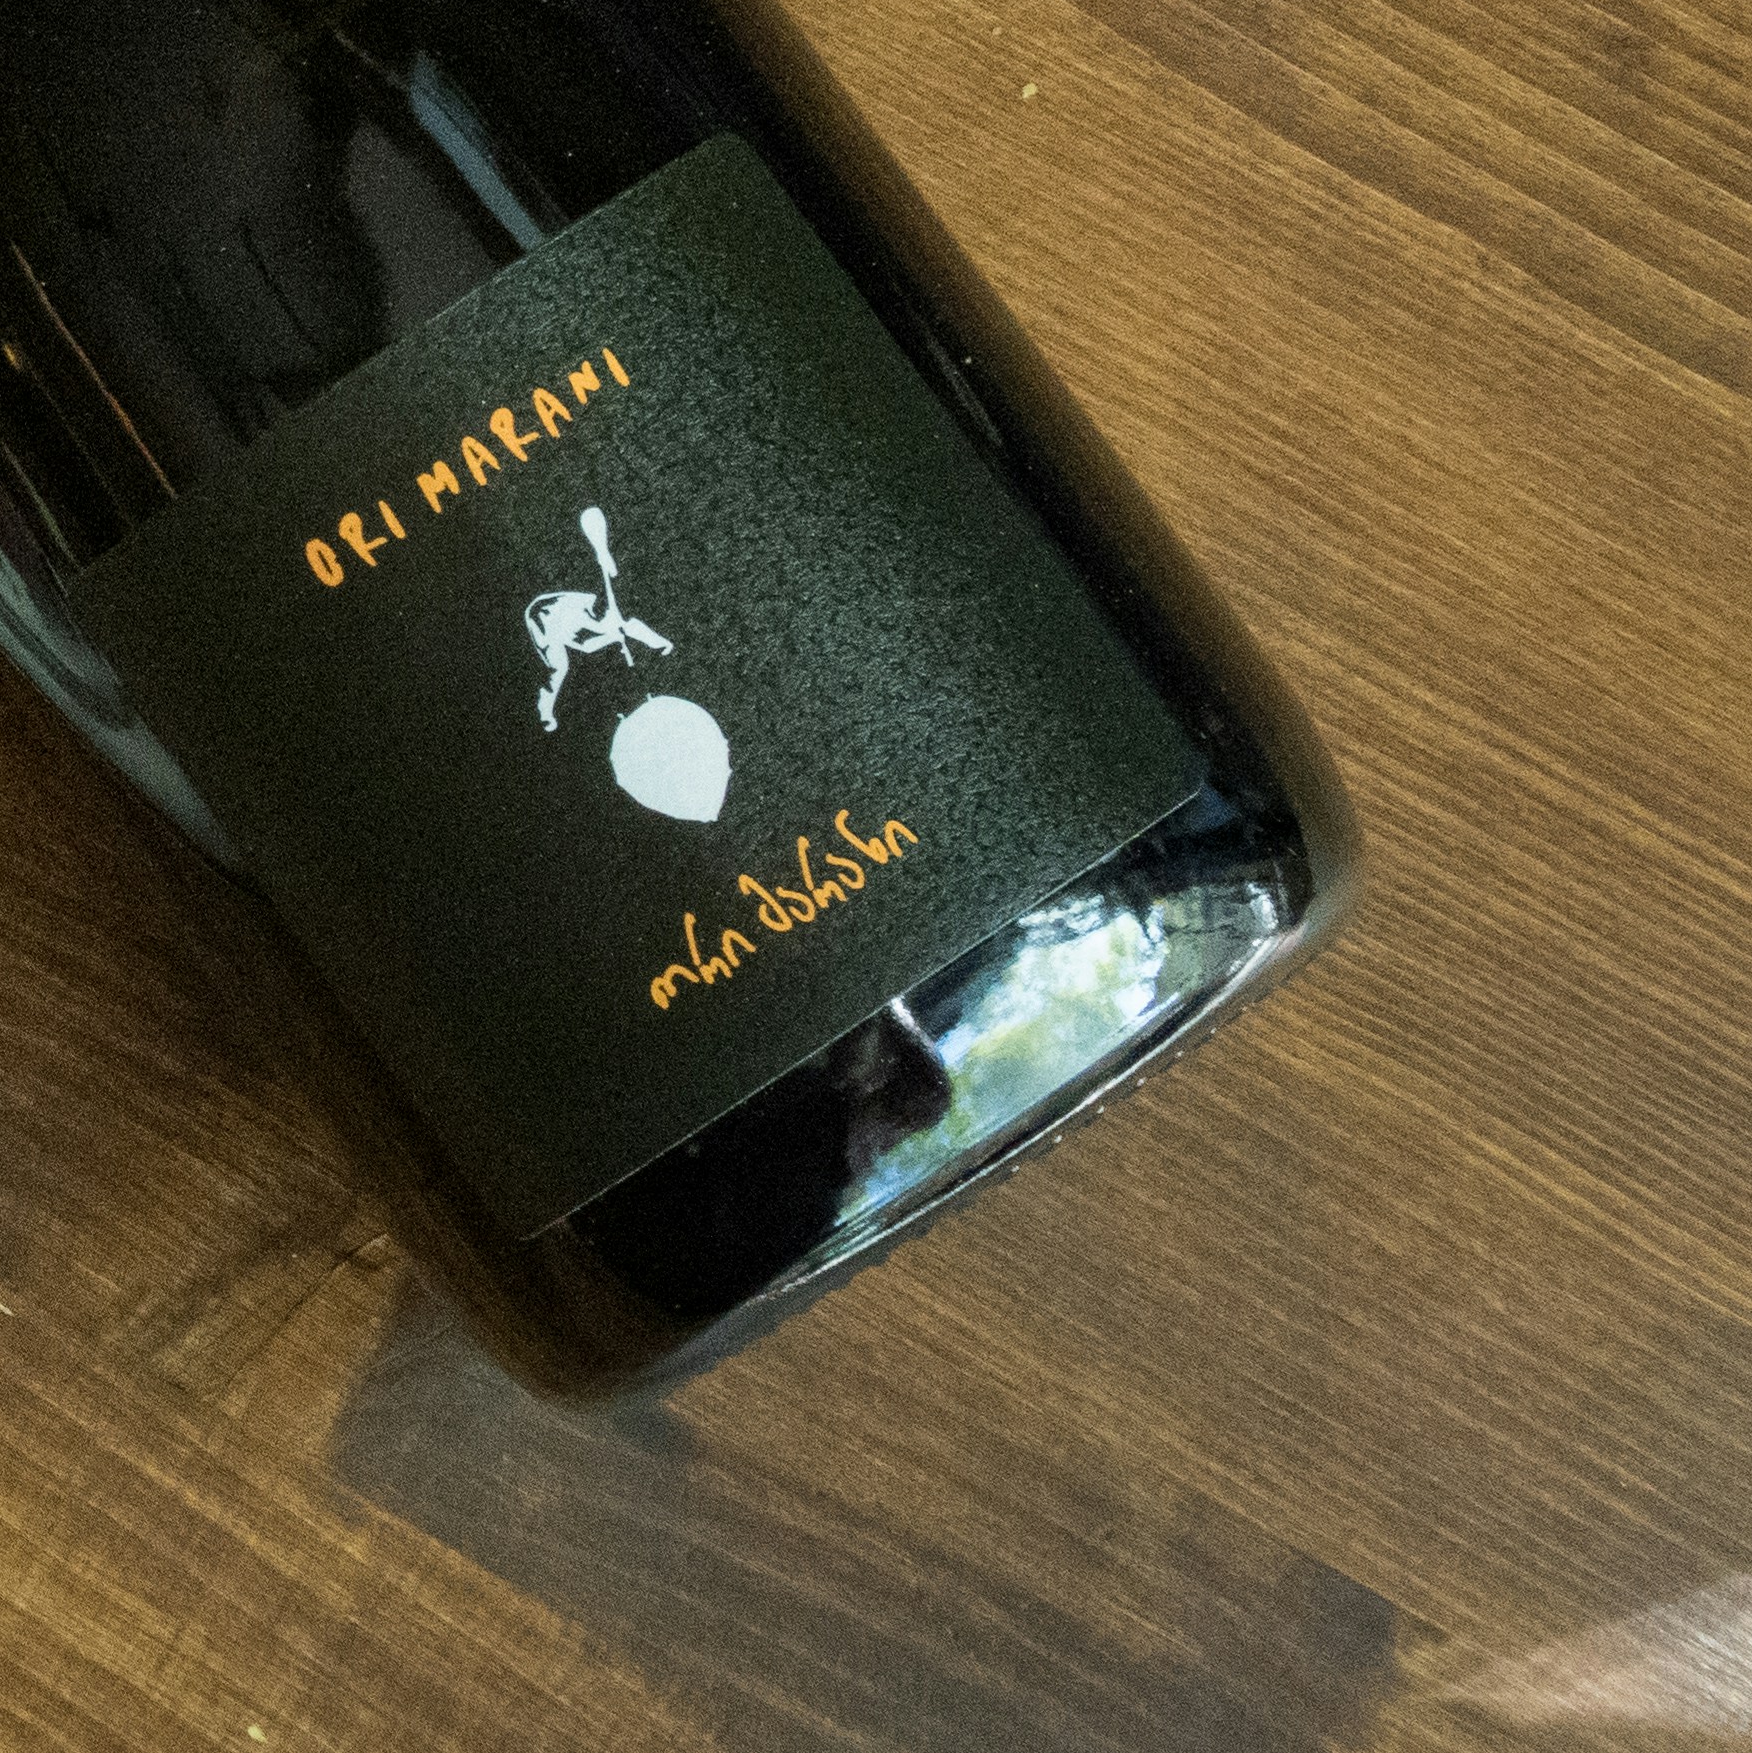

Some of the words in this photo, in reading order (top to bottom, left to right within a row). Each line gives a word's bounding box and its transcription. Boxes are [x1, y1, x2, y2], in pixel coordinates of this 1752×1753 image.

[304, 500, 407, 588] ORI
[415, 347, 631, 514] MARANI
[649, 911, 757, 1010] ორი
[738, 808, 919, 933] მარანი
